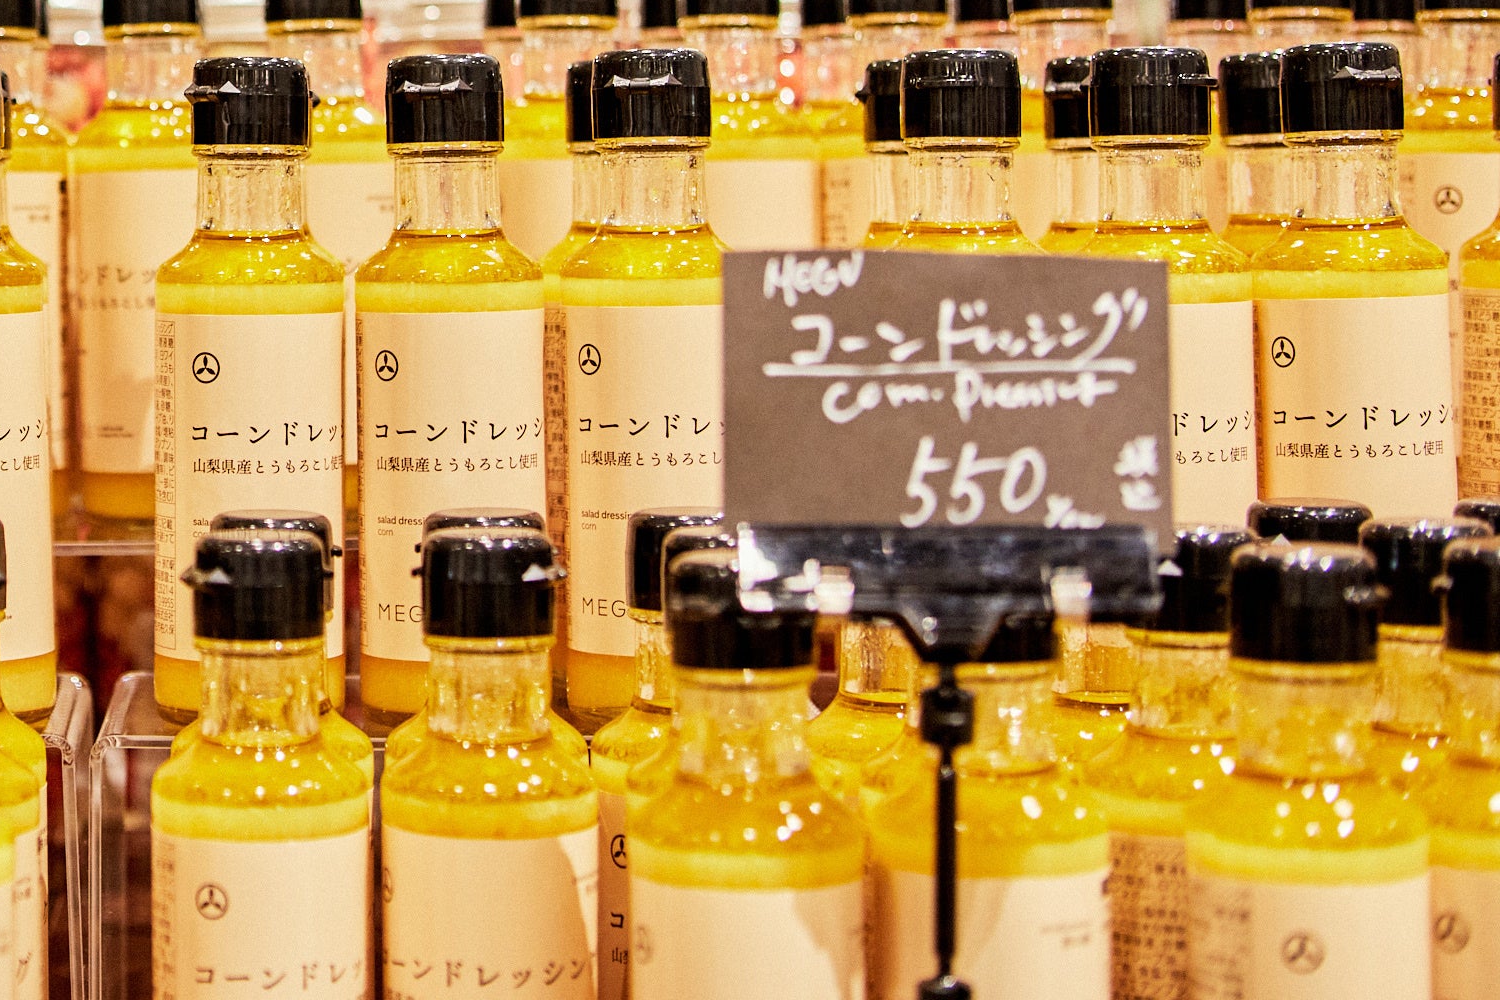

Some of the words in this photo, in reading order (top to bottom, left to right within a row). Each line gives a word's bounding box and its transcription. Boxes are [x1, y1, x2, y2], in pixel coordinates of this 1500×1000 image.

[580, 450, 723, 468] 山梨県産とうもろこし
[1175, 446, 1248, 465] もろこし使用
[1275, 440, 1444, 459] 山梨県産とうもろこし使用
[376, 453, 538, 473] 山梨県産とうもろこし使用
[900, 435, 1048, 528] 550
[192, 516, 209, 527] sala
[377, 515, 397, 526] salad
[398, 516, 425, 527] dressi
[581, 509, 600, 520] salad
[377, 527, 394, 537] corn
[581, 521, 597, 531] corn
[378, 603, 424, 623] MEG
[582, 597, 626, 618] MEG
[383, 951, 586, 988] ーンドレッシン
